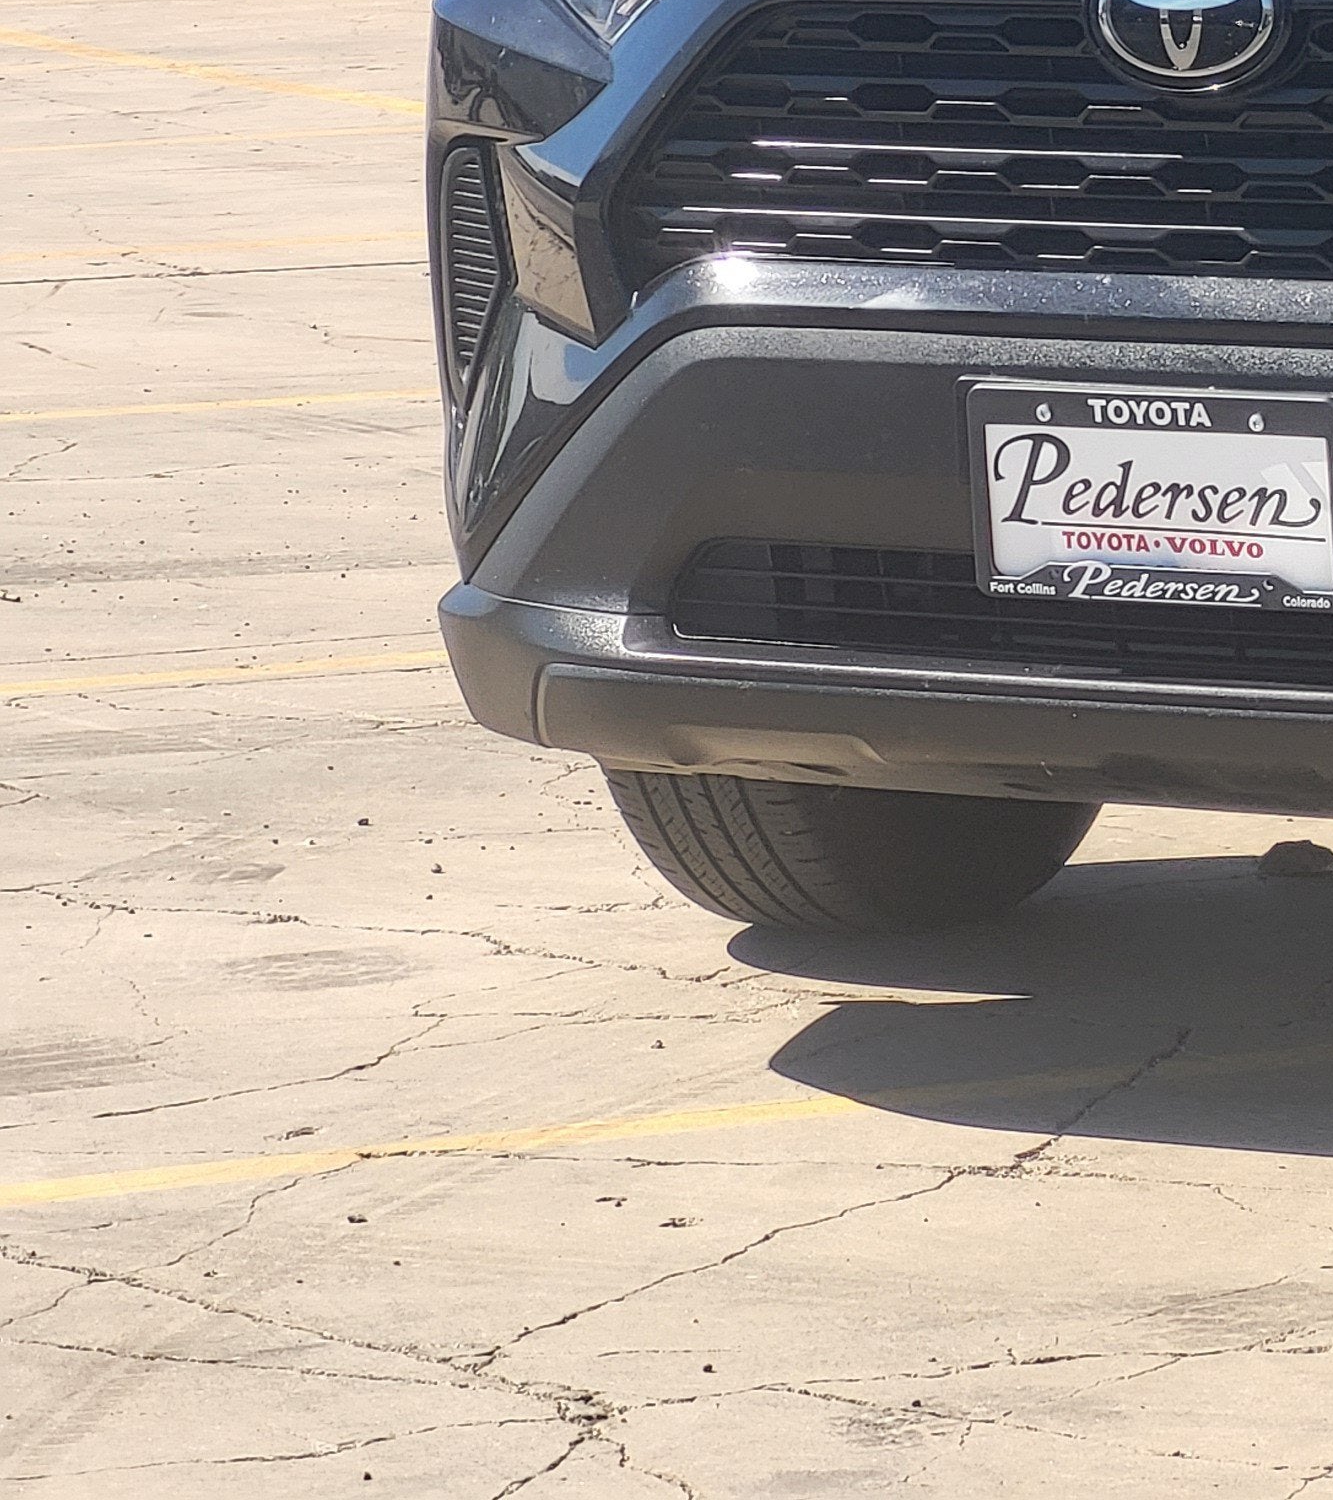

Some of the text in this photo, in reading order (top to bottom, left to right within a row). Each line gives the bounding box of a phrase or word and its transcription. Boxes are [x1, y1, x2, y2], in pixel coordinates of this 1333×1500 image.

[1087, 398, 1212, 428] TOYOTA
[993, 433, 1321, 528] Pedersen
[989, 582, 1056, 596] Fort Collins
[1062, 560, 1260, 602] Pedersen
[1282, 595, 1331, 610] Colorado
